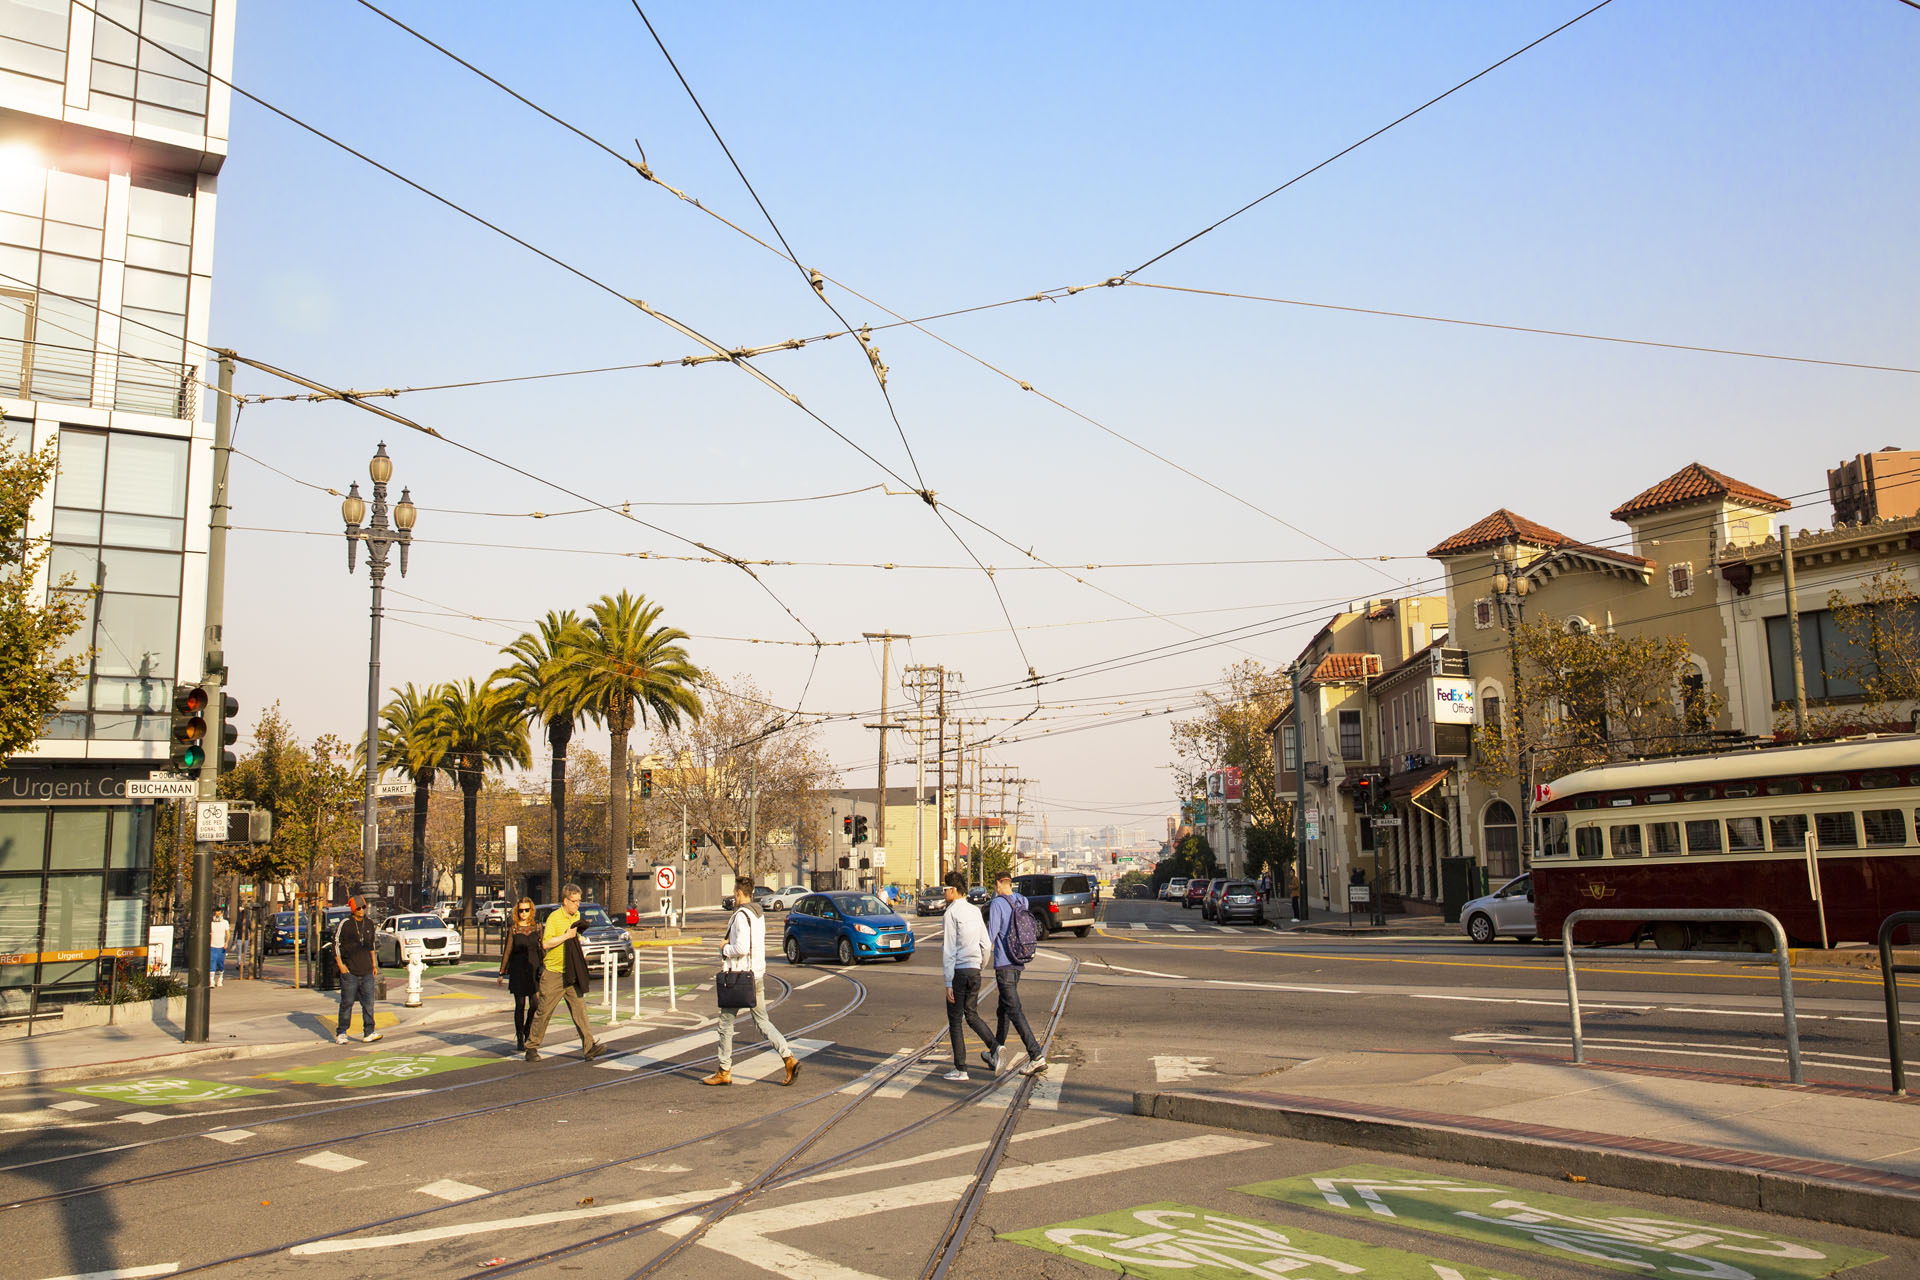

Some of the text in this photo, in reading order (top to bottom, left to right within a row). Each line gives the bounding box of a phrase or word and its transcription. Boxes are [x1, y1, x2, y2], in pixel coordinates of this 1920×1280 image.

[1437, 688, 1463, 701] FedEx
[1452, 702, 1474, 714] Office
[12, 776, 92, 801] Urgent
[131, 784, 192, 794] BUCHANAN
[382, 785, 408, 793] MARKET
[0, 948, 134, 964] RECT Urgent Care
